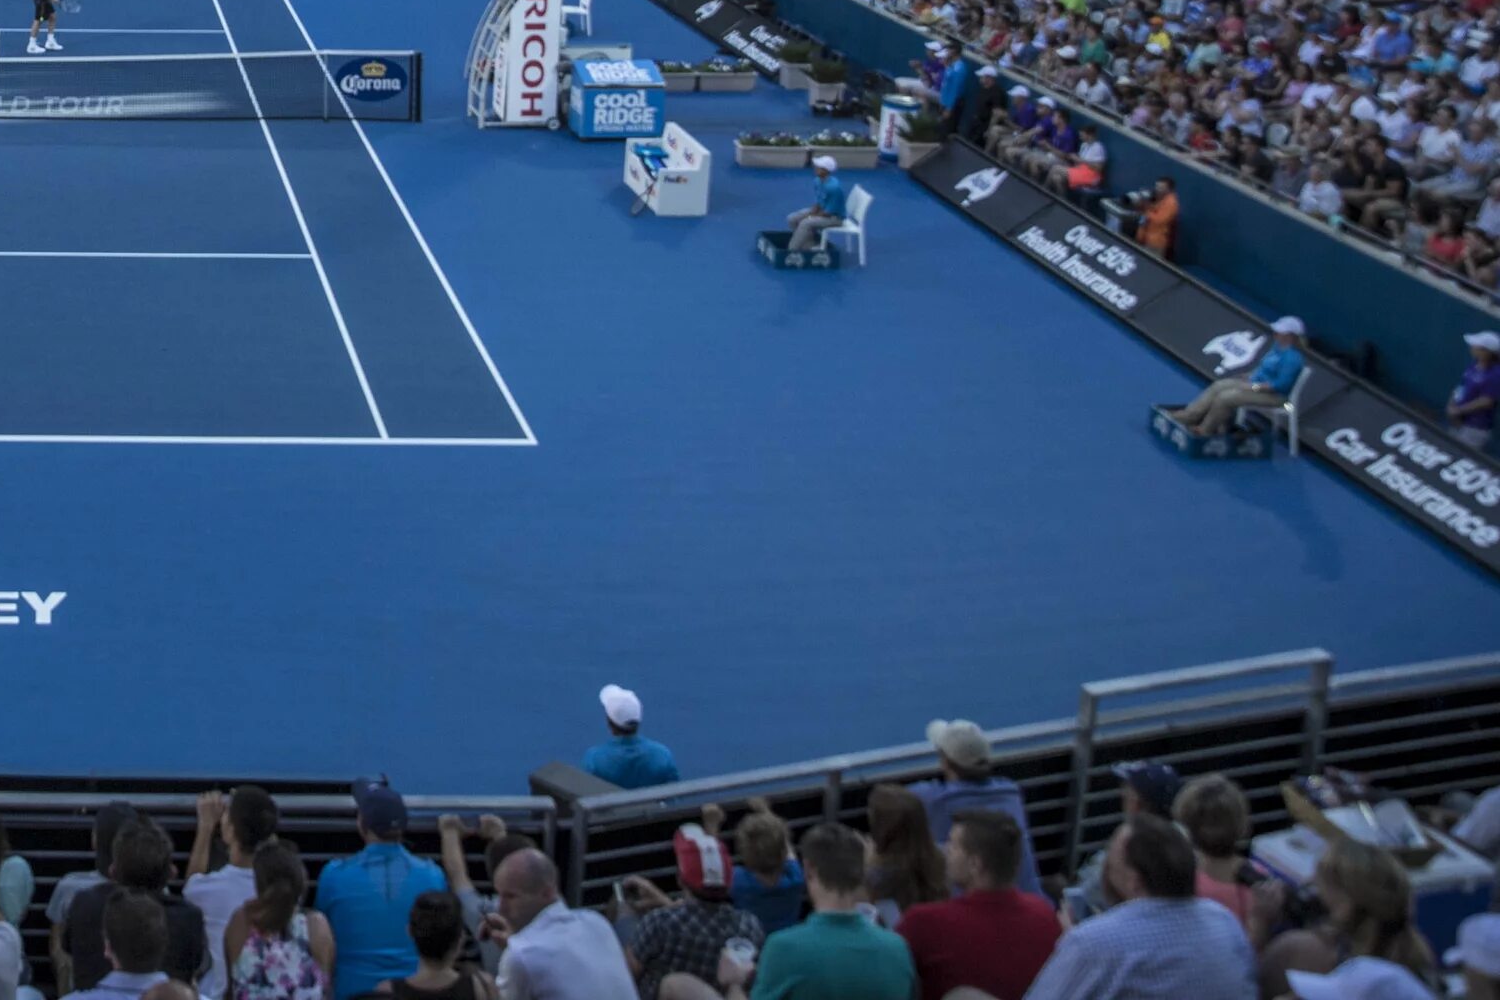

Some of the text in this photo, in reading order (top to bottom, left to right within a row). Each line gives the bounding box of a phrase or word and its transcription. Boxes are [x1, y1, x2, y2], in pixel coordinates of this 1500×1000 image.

[43, 95, 124, 114] TOUR
[340, 74, 402, 96] Corona
[1017, 226, 1138, 310] Health Insurance
[1064, 225, 1137, 277] Over 50's
[1325, 427, 1499, 548] Car Insurance
[1381, 422, 1500, 507] Over 50's
